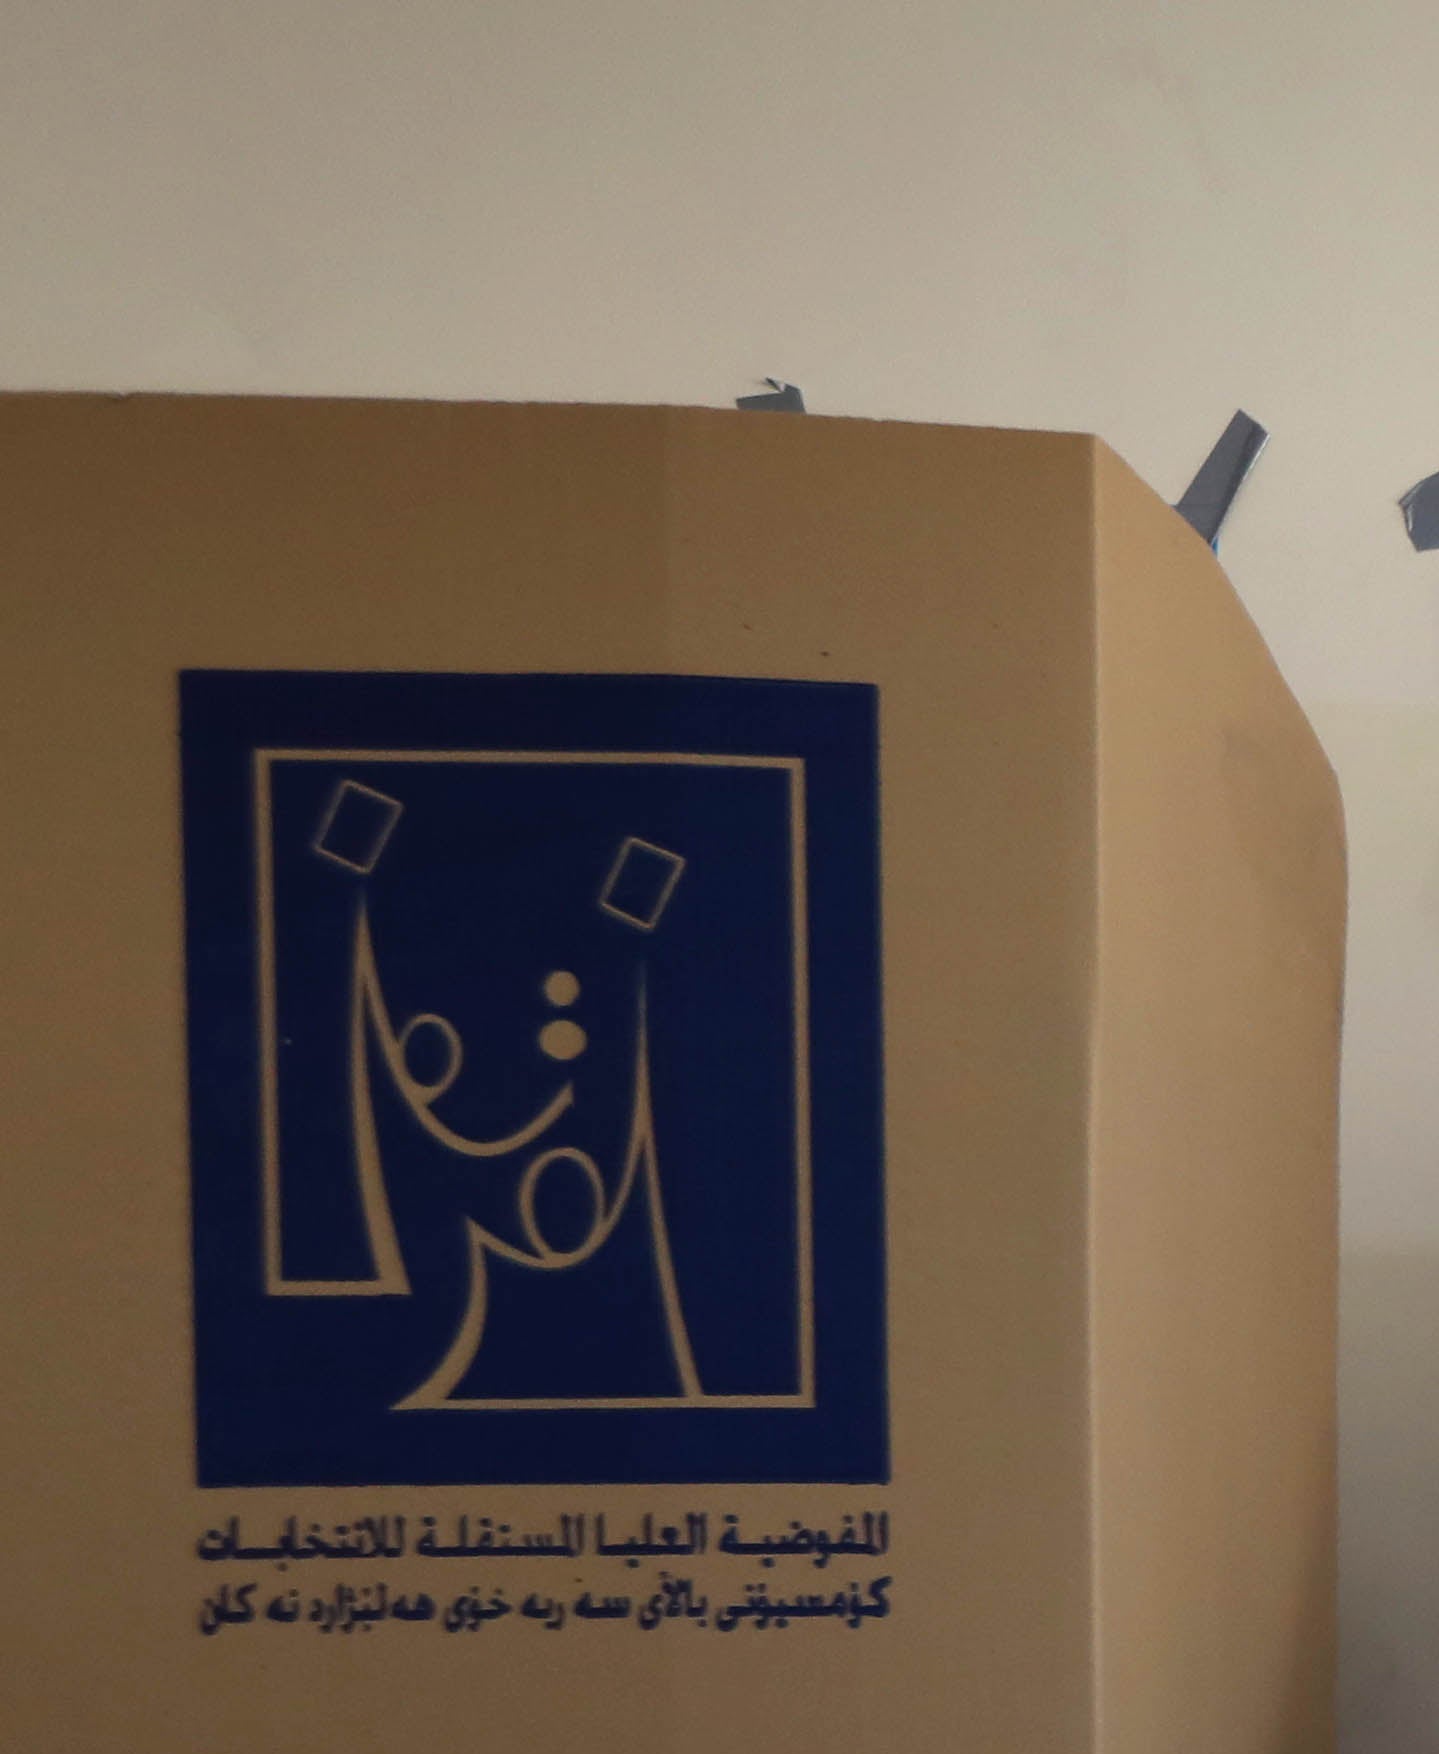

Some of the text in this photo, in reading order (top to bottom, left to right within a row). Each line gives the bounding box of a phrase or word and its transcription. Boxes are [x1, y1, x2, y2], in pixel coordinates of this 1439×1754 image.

[196, 1511, 889, 1569] المفوضية العليا المستقلة للانتخابات
